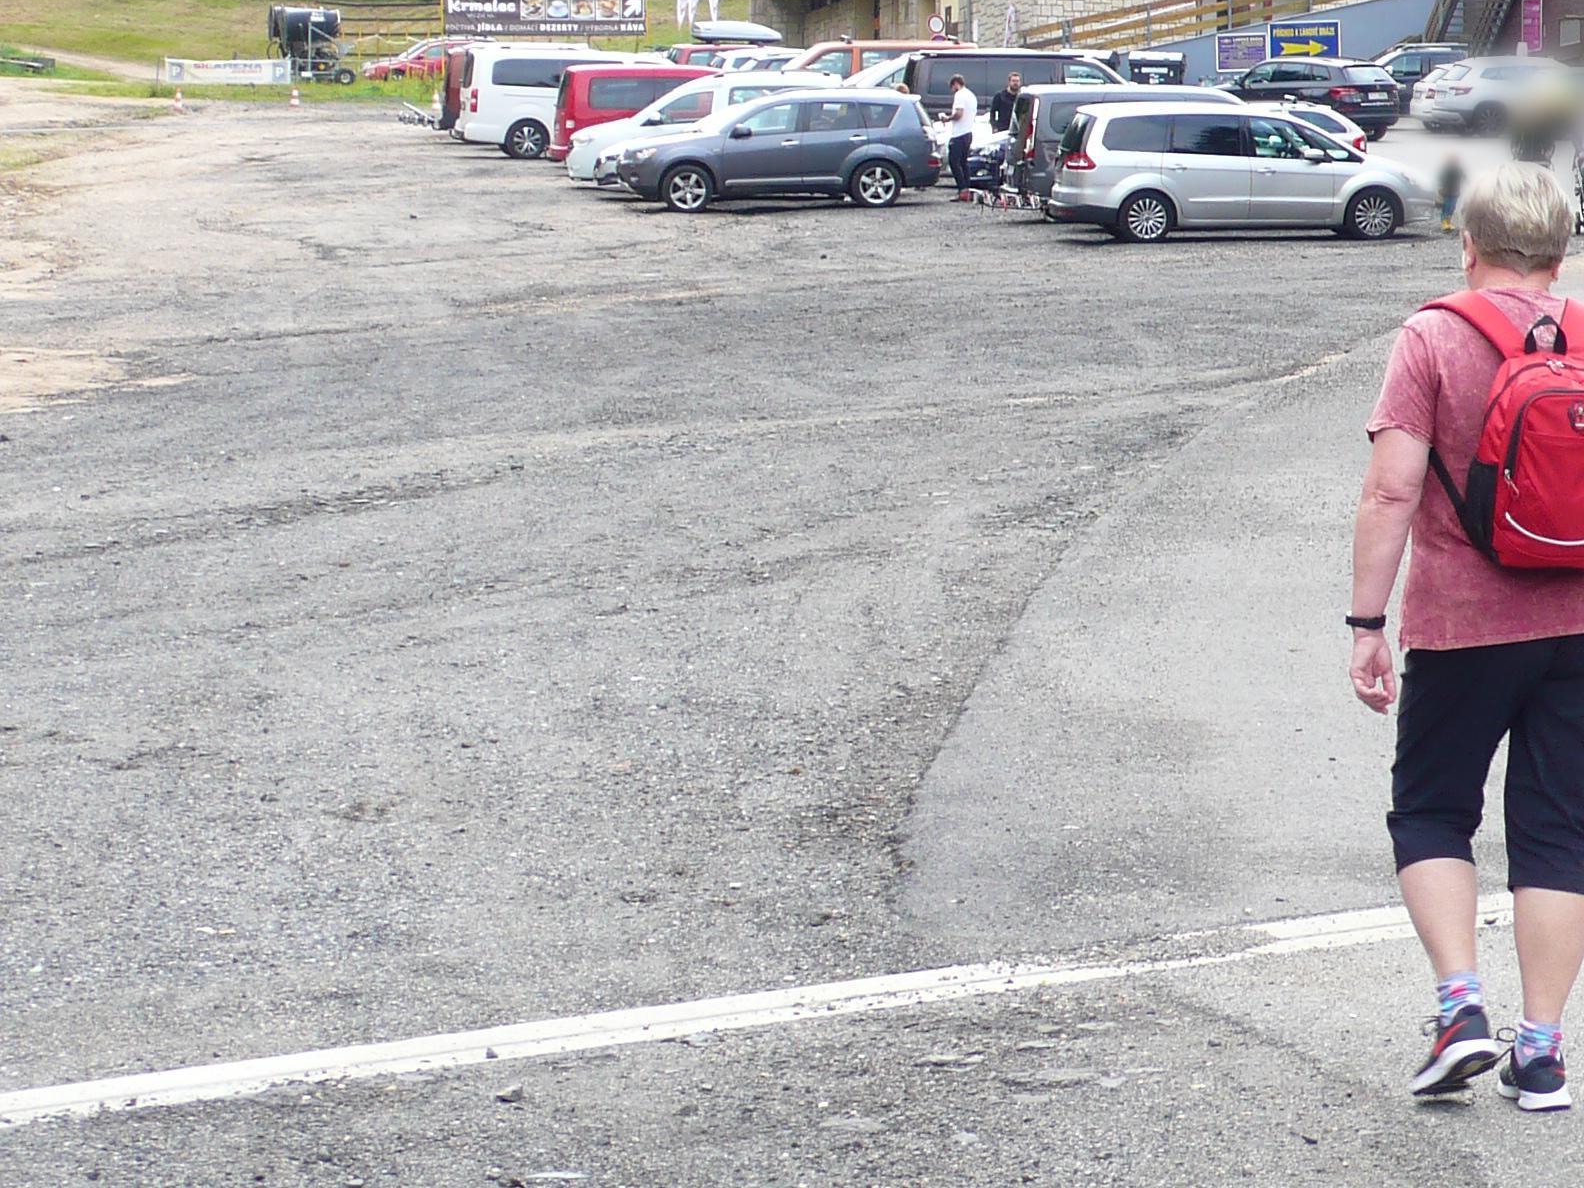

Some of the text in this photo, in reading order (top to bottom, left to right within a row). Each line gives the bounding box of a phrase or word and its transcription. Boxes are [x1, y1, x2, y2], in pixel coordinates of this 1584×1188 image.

[476, 21, 503, 32] JÍDLA
[539, 23, 579, 32] DEZERTY
[620, 21, 645, 32] KÁVA
[172, 66, 180, 77] P
[275, 66, 284, 78] P
